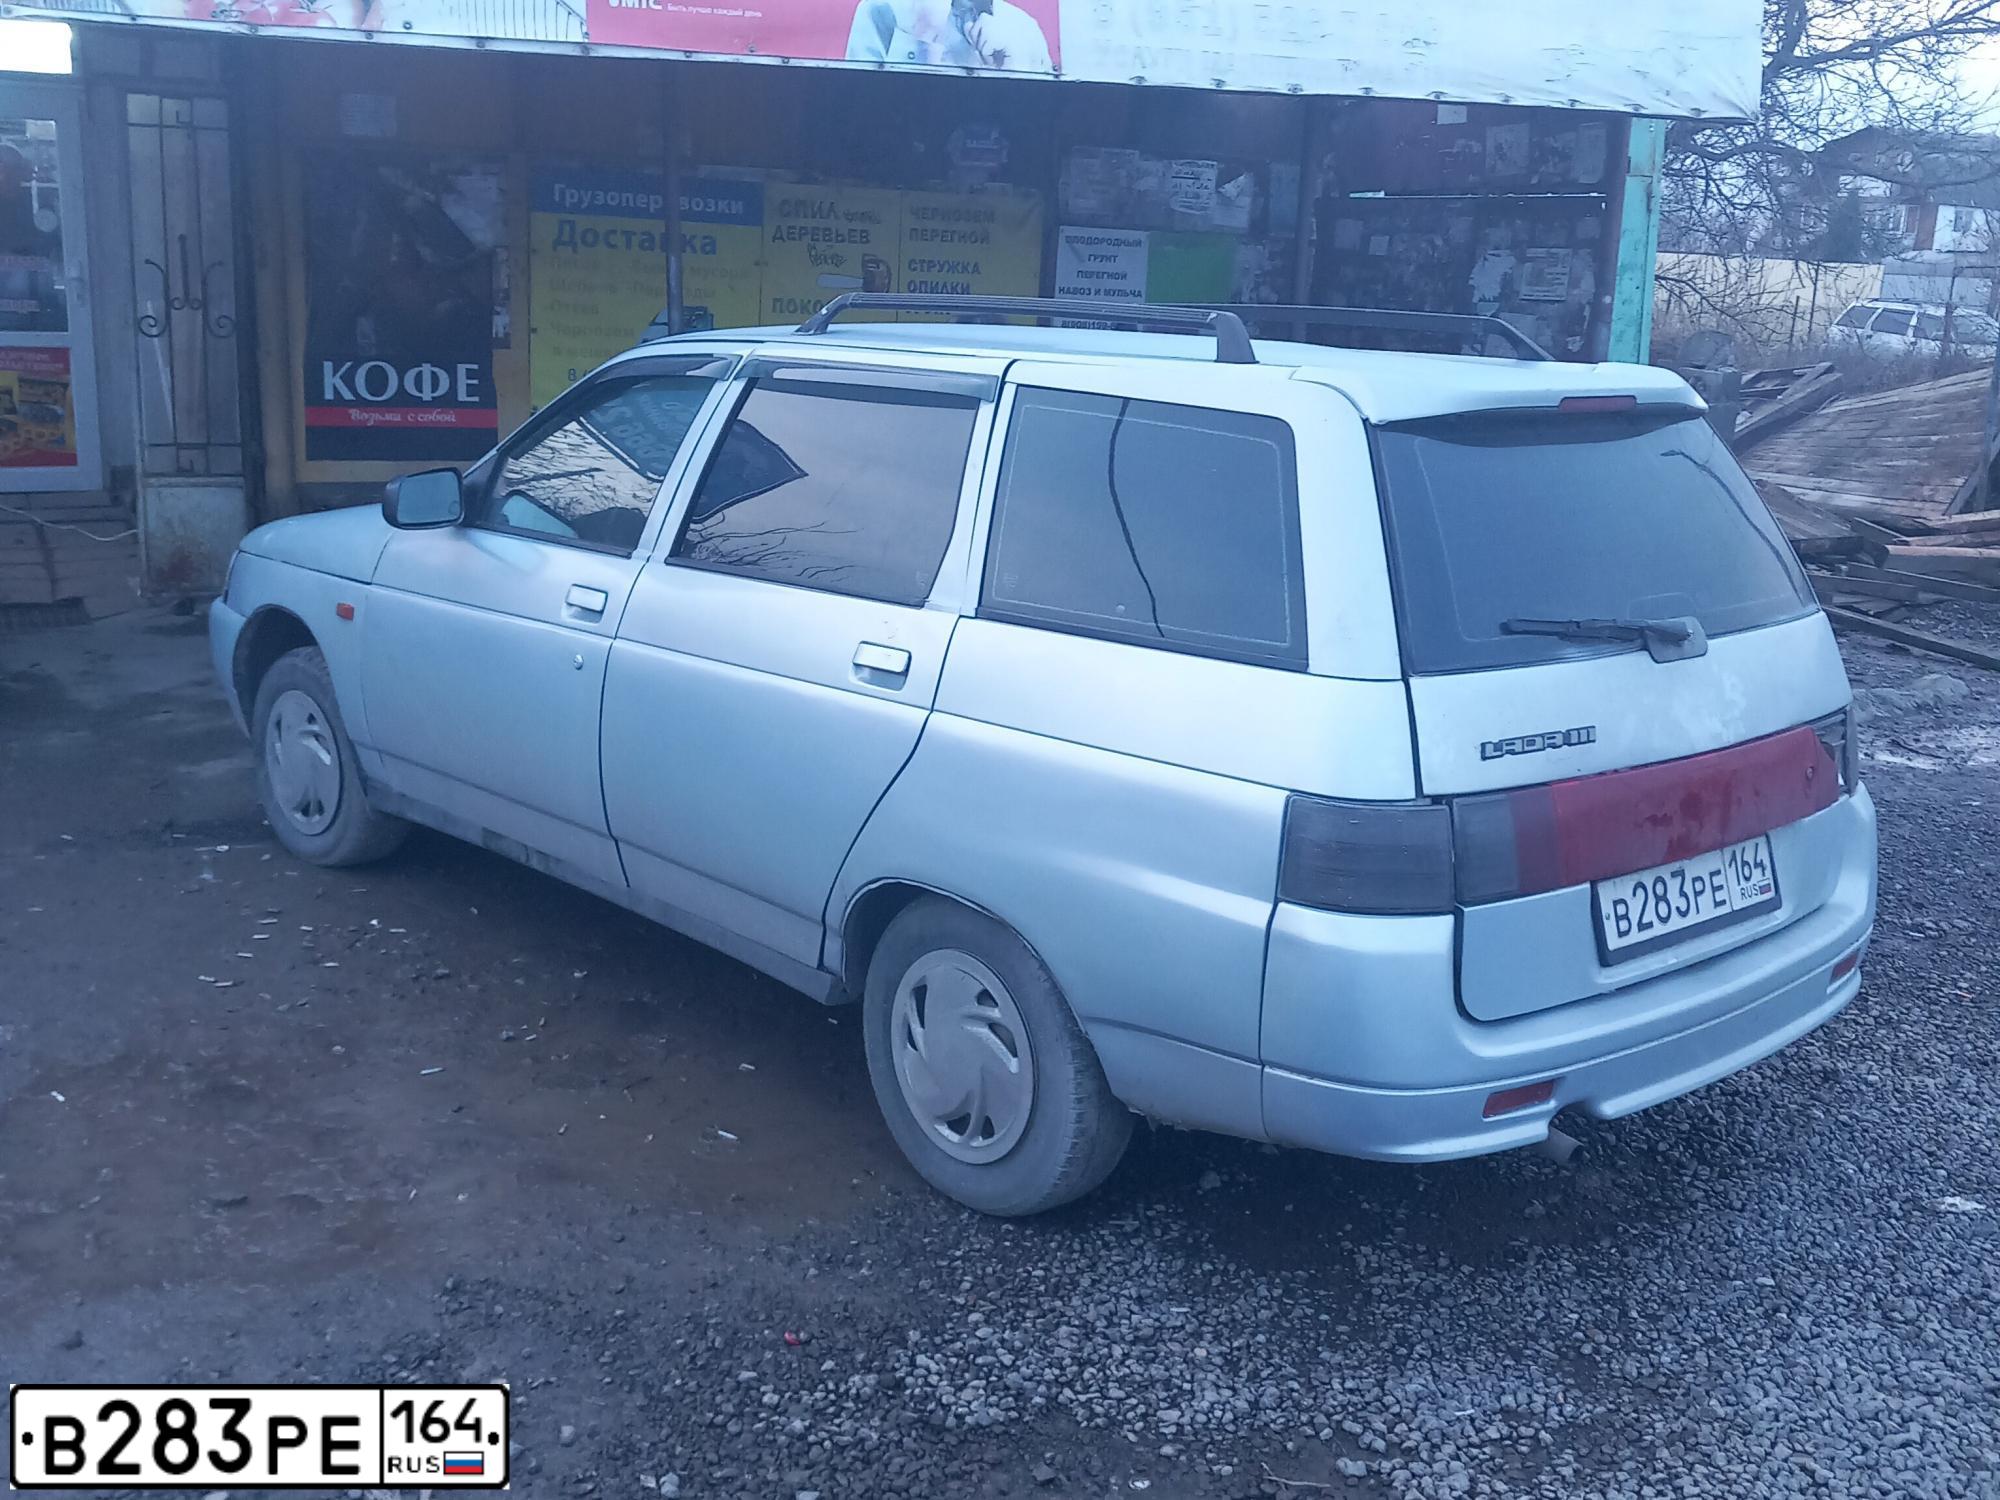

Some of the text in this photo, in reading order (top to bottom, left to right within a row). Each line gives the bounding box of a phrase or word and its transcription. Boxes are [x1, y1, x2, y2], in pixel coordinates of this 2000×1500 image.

[553, 184, 743, 214] Грузопервозки
[778, 199, 840, 221] СПИЛ
[772, 224, 871, 245] ДЕРЕВЬЕВ
[908, 227, 991, 245] ПЕРЕГНОЙ
[908, 258, 982, 275] СТРУЖКА
[1087, 253, 1119, 264] ГРУНТ
[1076, 269, 1128, 280] ПЕРЕГНОЙ
[907, 279, 971, 295] ОПИЛКИ
[1058, 286, 1143, 298] НАВОЗ И МУЛЬЧА
[322, 361, 480, 402] КОФЕ
[348, 408, 456, 426] Возьми с собой
[1481, 730, 1564, 761] LADA
[1728, 843, 1768, 886] 164
[1741, 886, 1760, 900] RUS
[1612, 869, 1727, 938] В283РЕ
